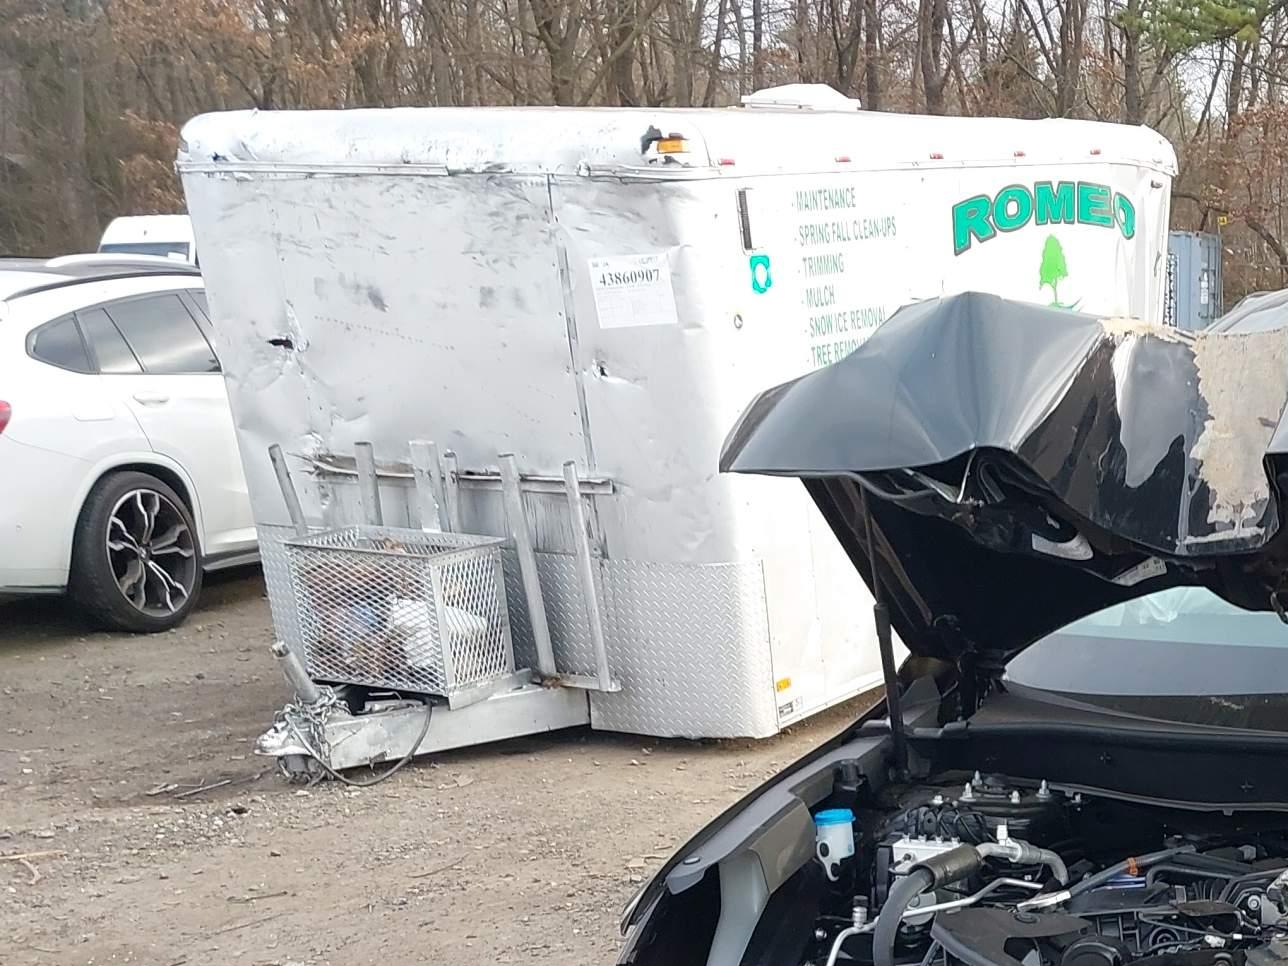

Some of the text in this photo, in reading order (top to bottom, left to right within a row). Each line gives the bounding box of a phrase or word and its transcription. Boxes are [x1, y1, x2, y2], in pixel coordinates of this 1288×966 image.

[796, 187, 856, 212] MAINTENANCE
[953, 180, 1135, 256] ROMEO
[799, 216, 896, 247] SPRING FALL CLEAN-UPS
[600, 269, 660, 286] 43860907
[803, 252, 844, 278] TRIMMING
[806, 284, 835, 308] MULCH
[809, 313, 833, 338] SNOW
[834, 312, 848, 333] ICE
[811, 343, 832, 367] TREE
